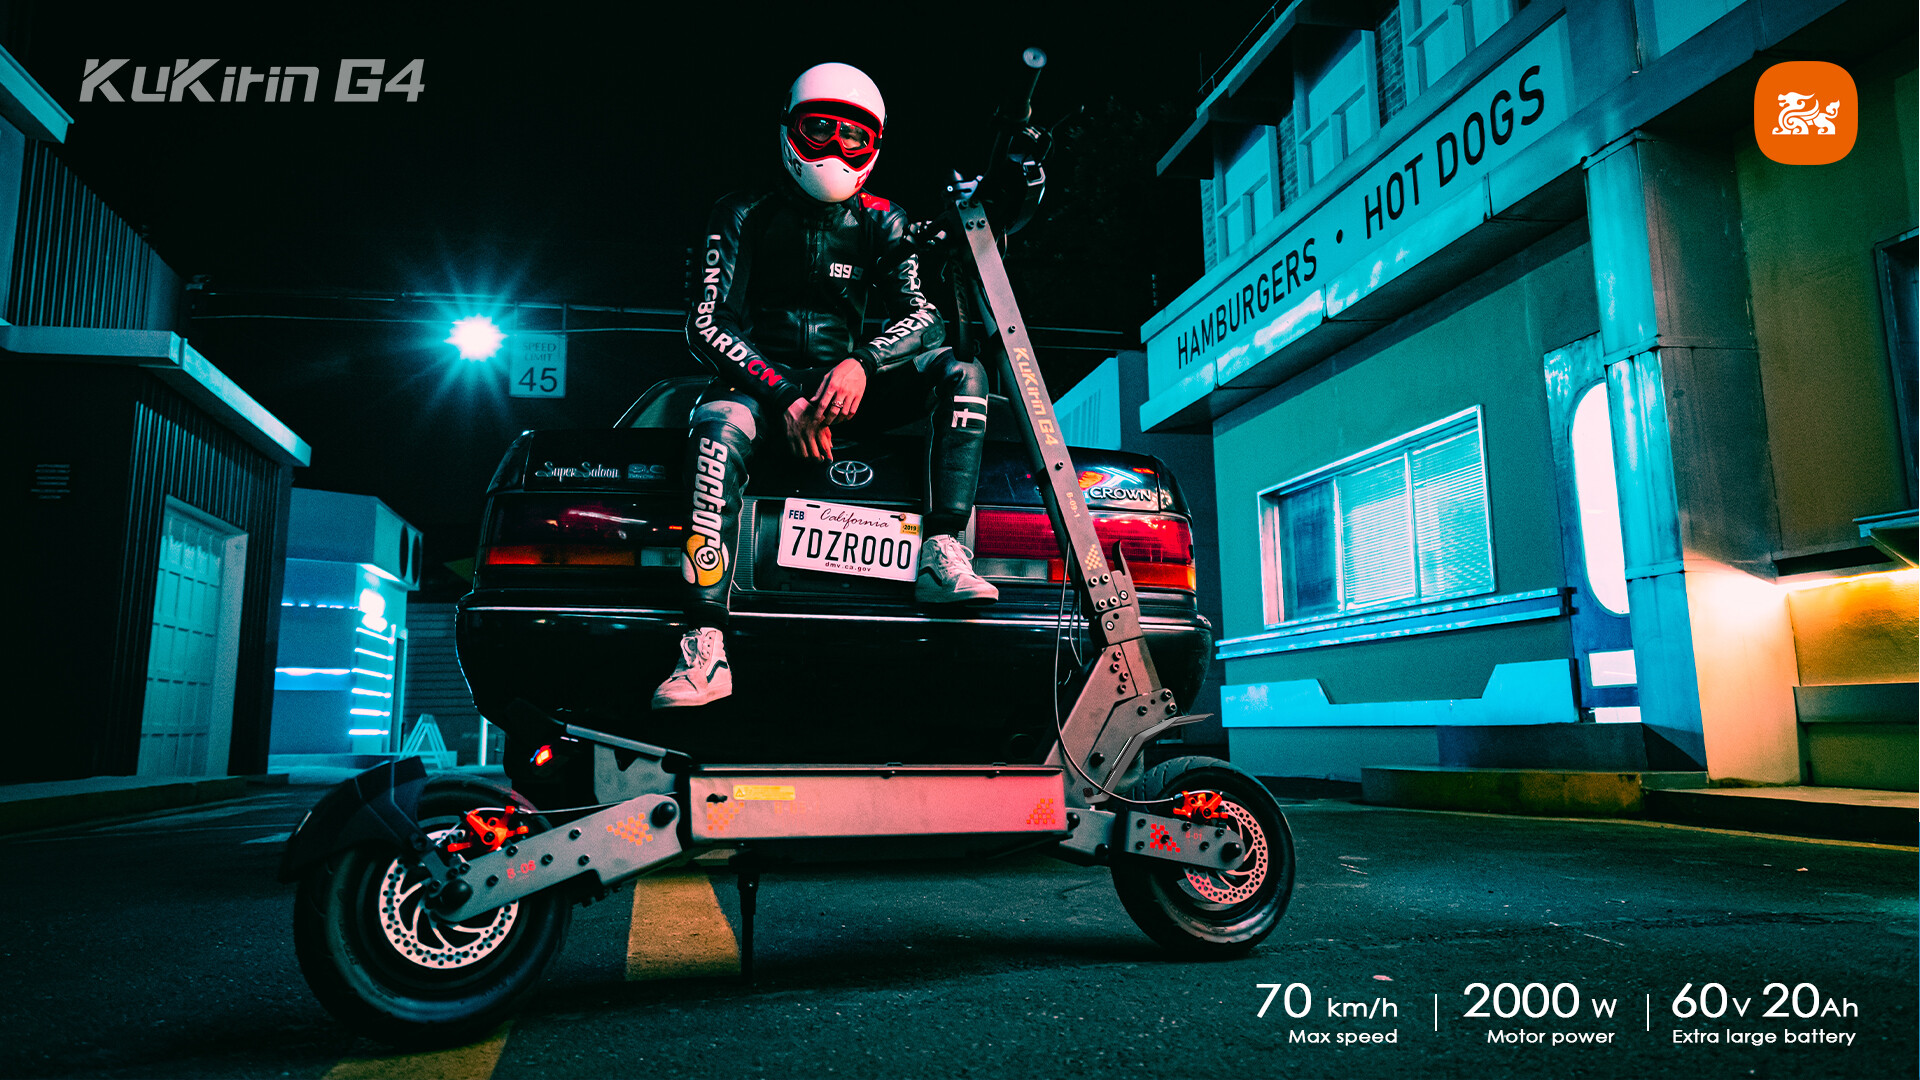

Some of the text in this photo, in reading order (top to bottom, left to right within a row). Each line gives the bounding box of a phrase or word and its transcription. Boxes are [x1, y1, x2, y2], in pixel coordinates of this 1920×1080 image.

[1176, 65, 1545, 370] HAMBURGERS HOT DOGS
[694, 234, 783, 387] LONGBOARD.CN
[522, 343, 557, 352] SPEED
[518, 366, 558, 393] 45
[1012, 346, 1059, 446] KuKirin G4
[535, 461, 575, 482] Super
[575, 461, 620, 480] Saloon
[1089, 486, 1152, 501] CROWN
[788, 509, 805, 520] FEB
[820, 508, 890, 530] California
[791, 525, 912, 570] 7DZR000
[824, 561, 871, 572] dmv.ca.gov
